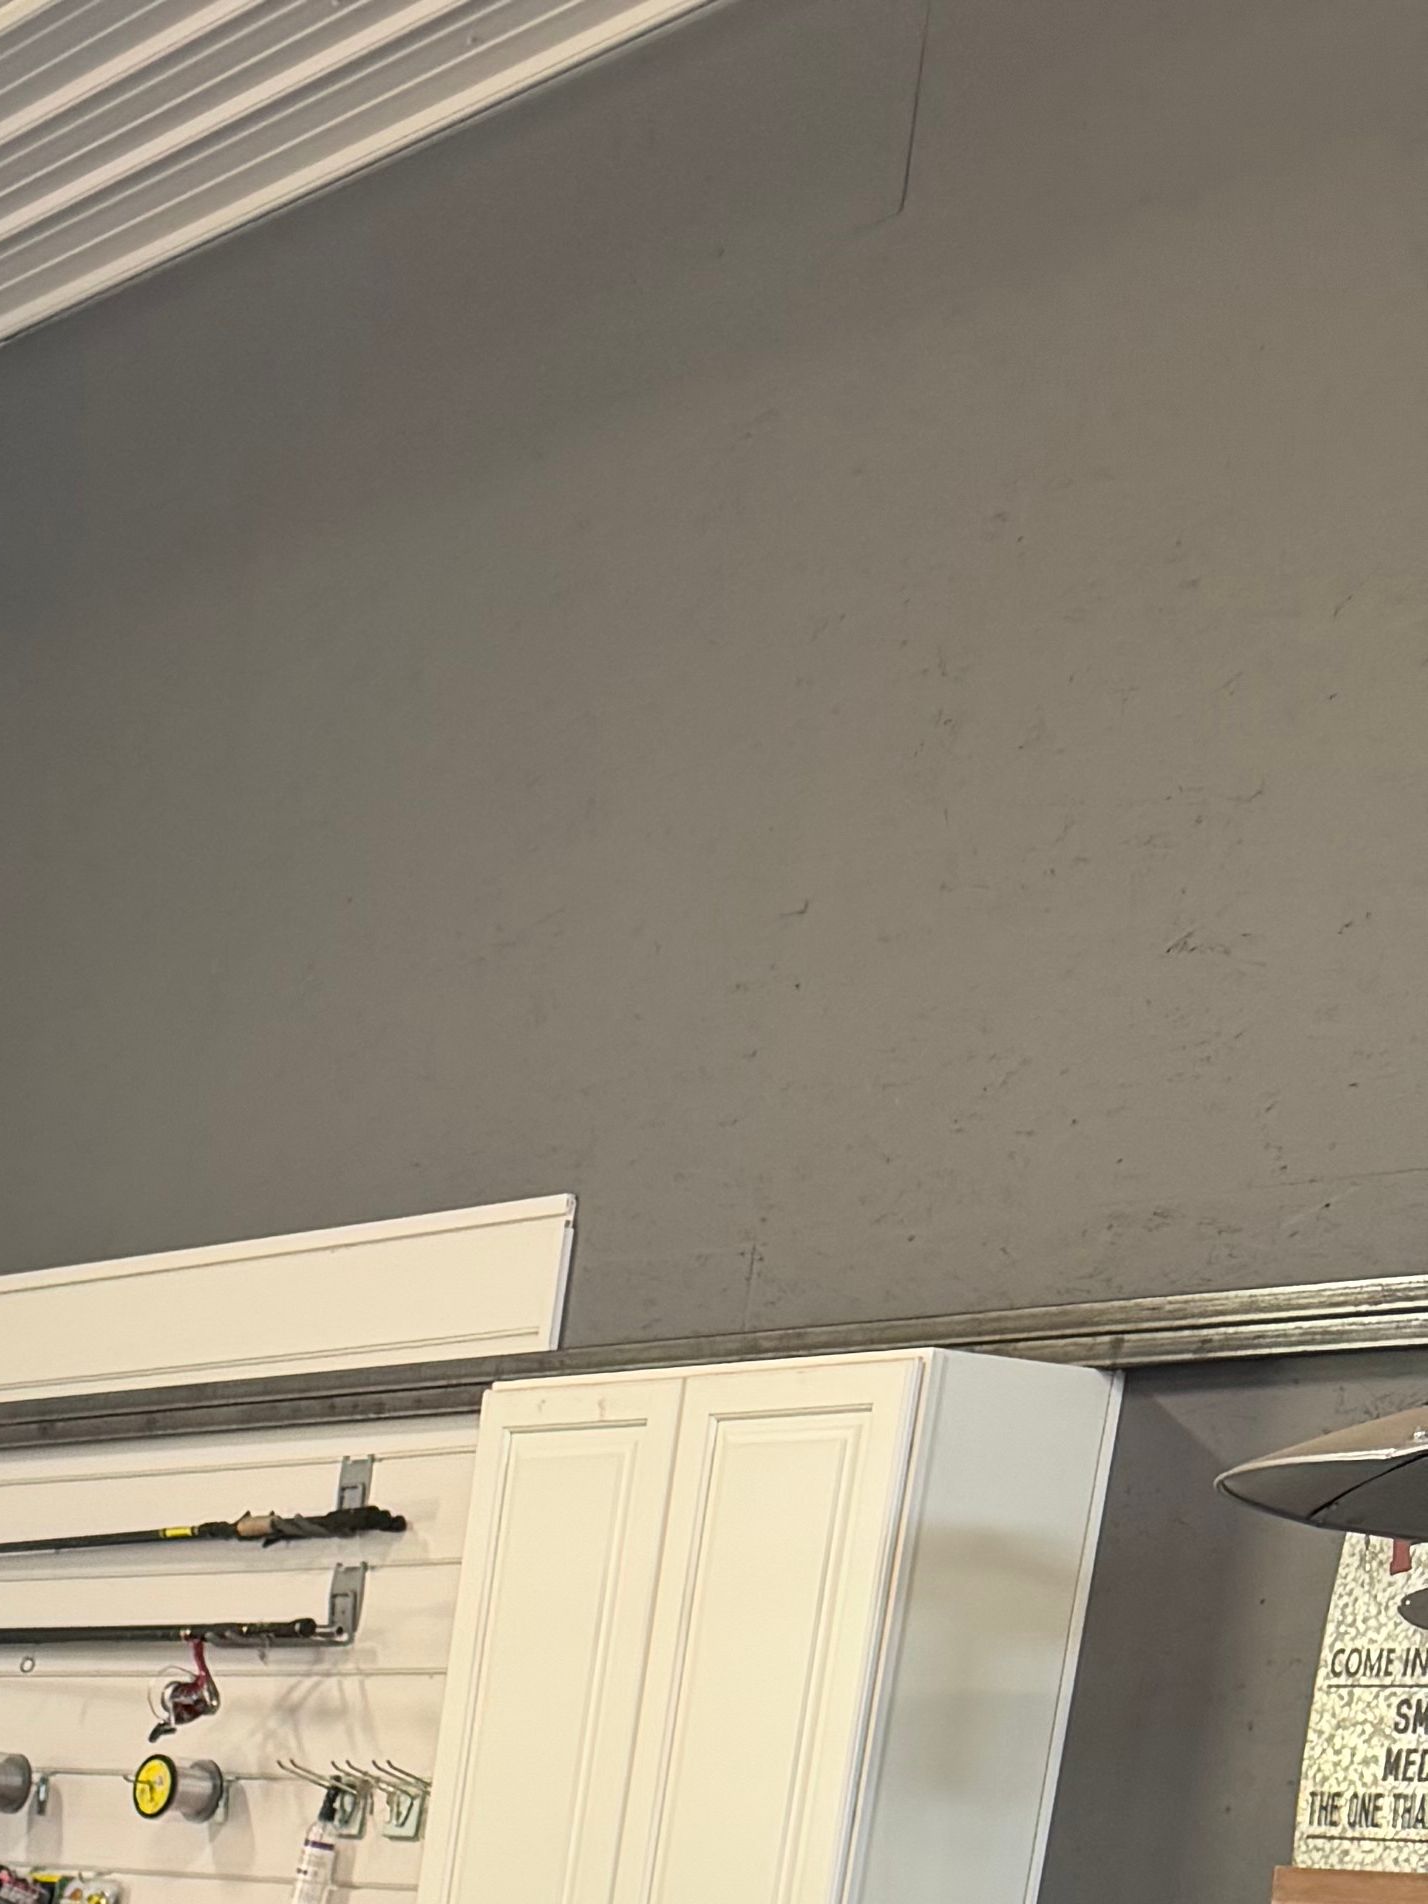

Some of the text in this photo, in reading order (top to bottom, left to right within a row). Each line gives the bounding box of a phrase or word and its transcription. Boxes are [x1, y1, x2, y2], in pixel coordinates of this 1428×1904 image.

[1330, 1647, 1396, 1678] COME
[1394, 1698, 1428, 1734] SM
[1381, 1746, 1428, 1782] MED
[1308, 1790, 1428, 1830] THE ONE THA
